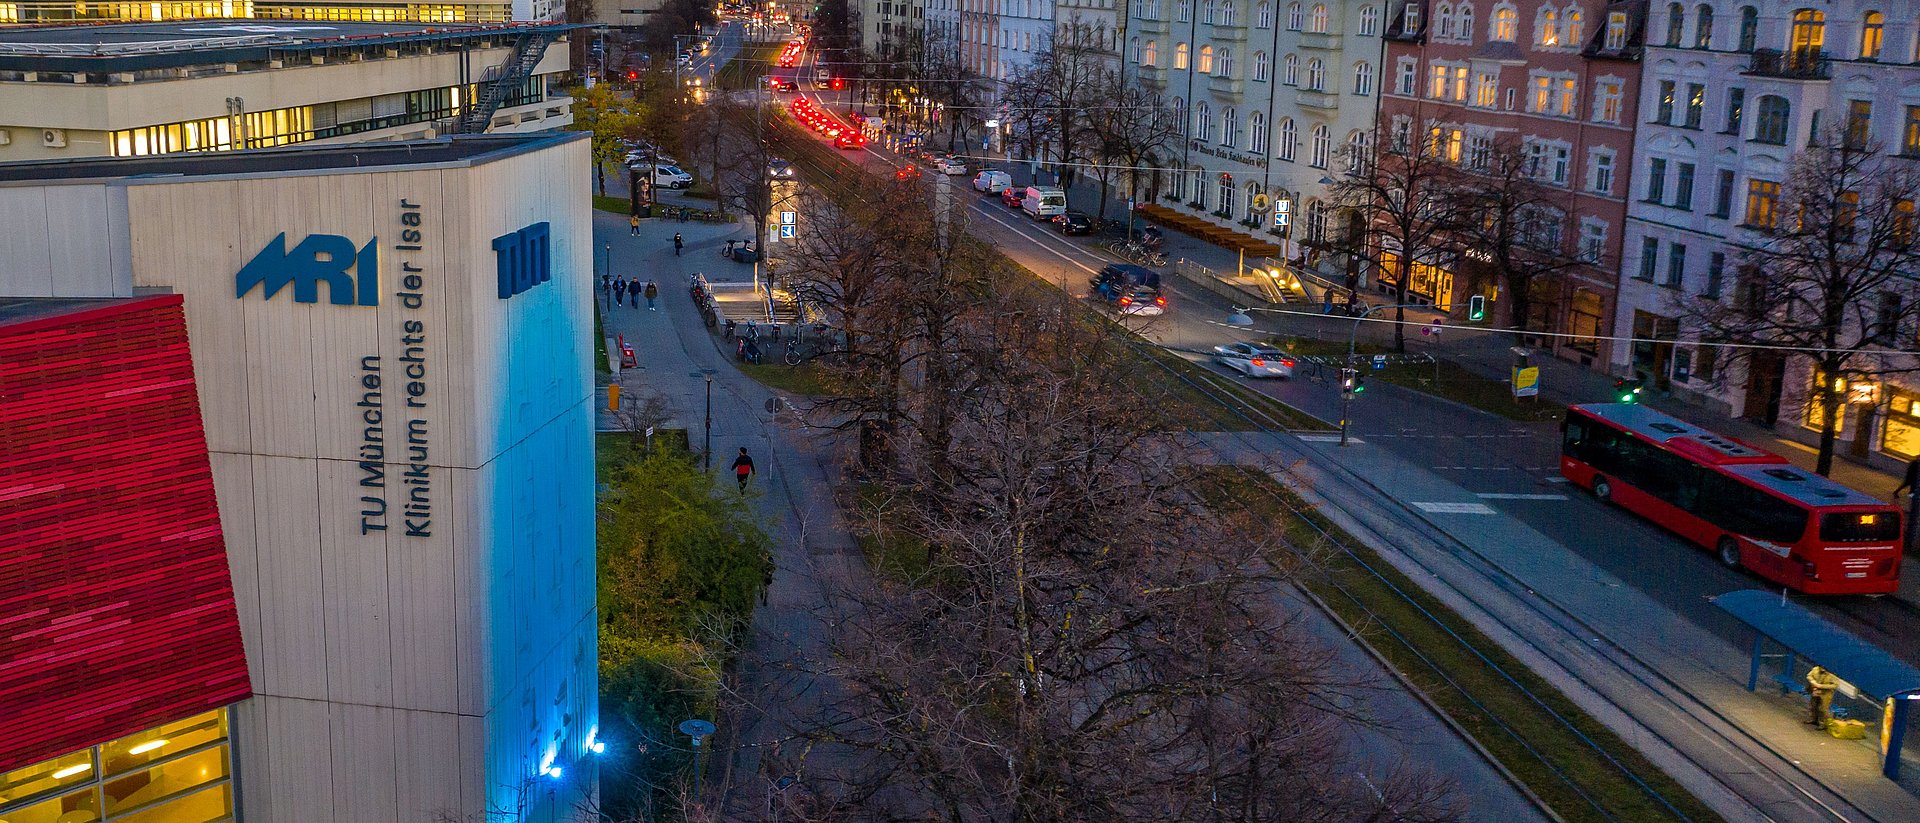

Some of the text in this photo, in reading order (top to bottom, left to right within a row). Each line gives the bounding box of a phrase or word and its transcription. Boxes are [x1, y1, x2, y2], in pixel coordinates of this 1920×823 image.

[236, 231, 380, 306] MRI
[357, 355, 388, 535] TU München
[396, 198, 431, 538] Klinikum rechts der Isar
